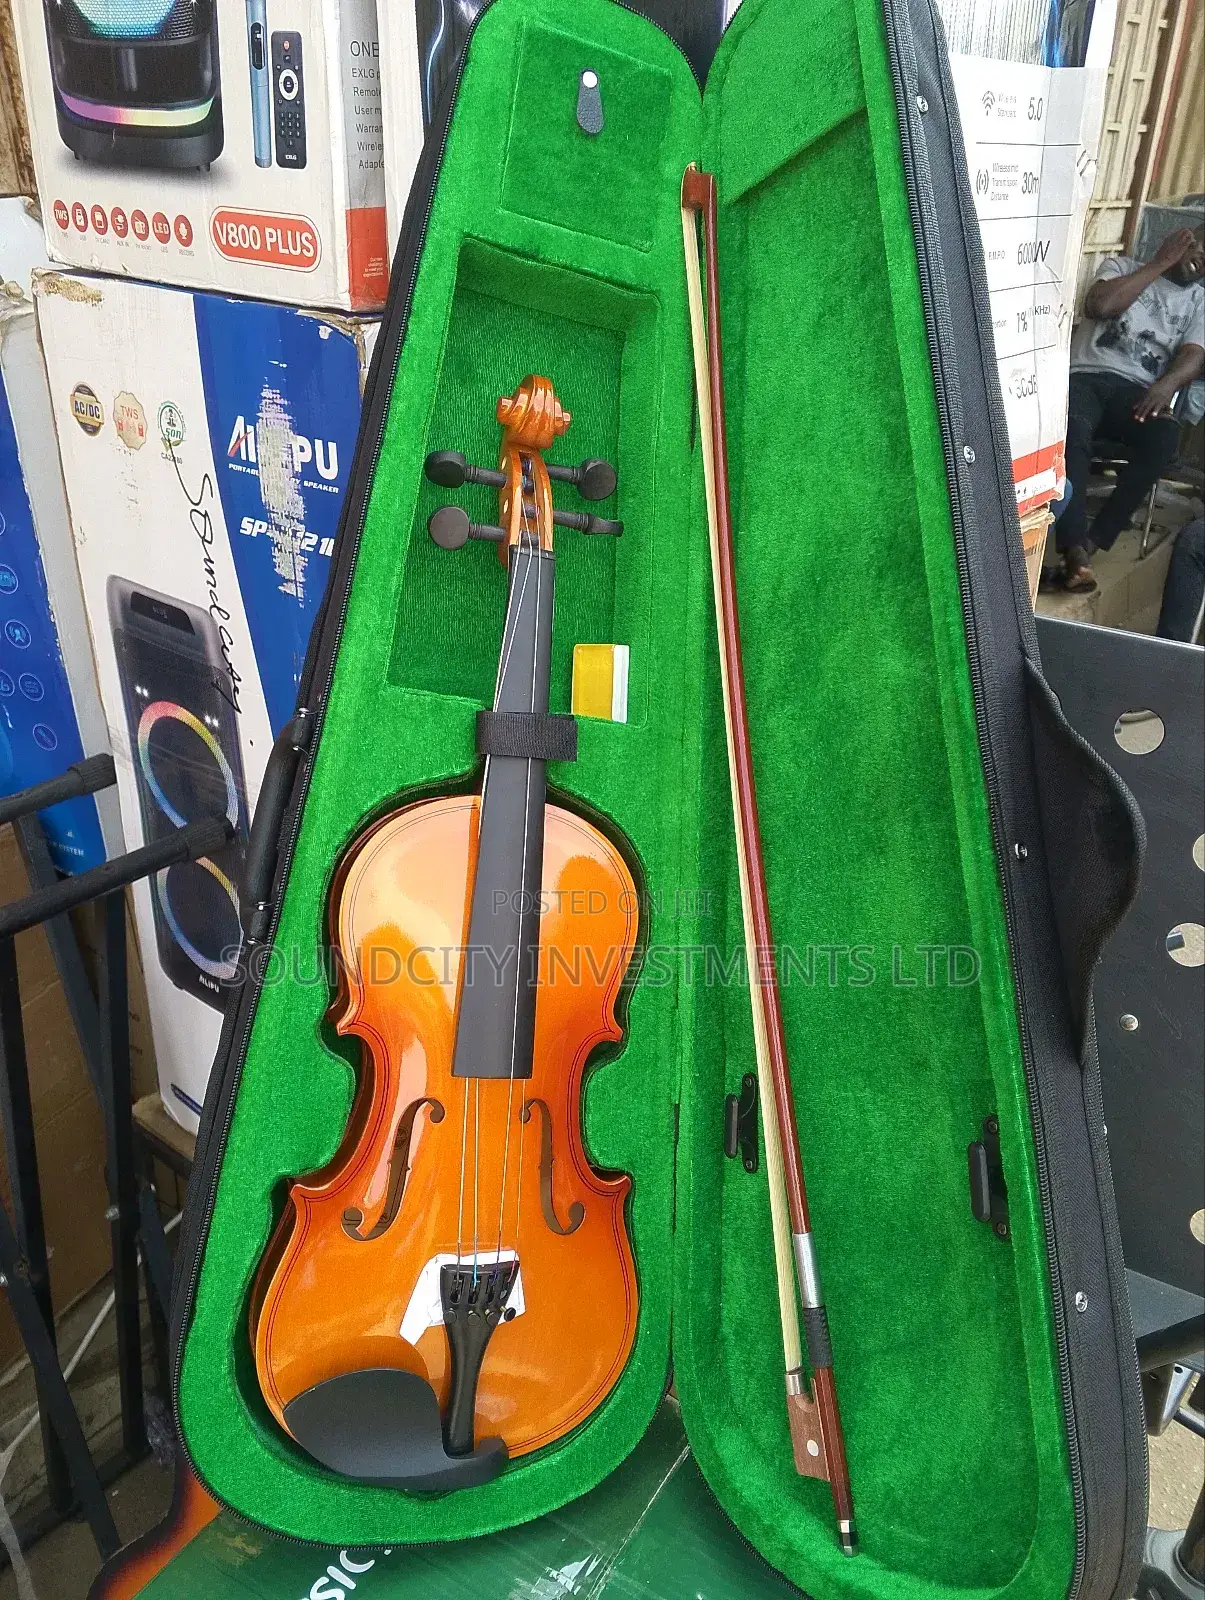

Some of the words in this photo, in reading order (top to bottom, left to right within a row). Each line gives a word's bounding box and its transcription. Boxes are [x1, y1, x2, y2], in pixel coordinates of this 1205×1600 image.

[351, 68, 375, 79] EXLG
[354, 106, 373, 115] User
[1027, 96, 1043, 121] 5.0
[1021, 171, 1040, 194] 30m
[54, 208, 68, 221] TWS
[153, 222, 169, 234] LED
[214, 220, 261, 251] V800
[264, 226, 315, 258] PLUS
[74, 400, 100, 420] AC/DC
[120, 406, 139, 420] TWS
[303, 480, 340, 494] SPEAKER
